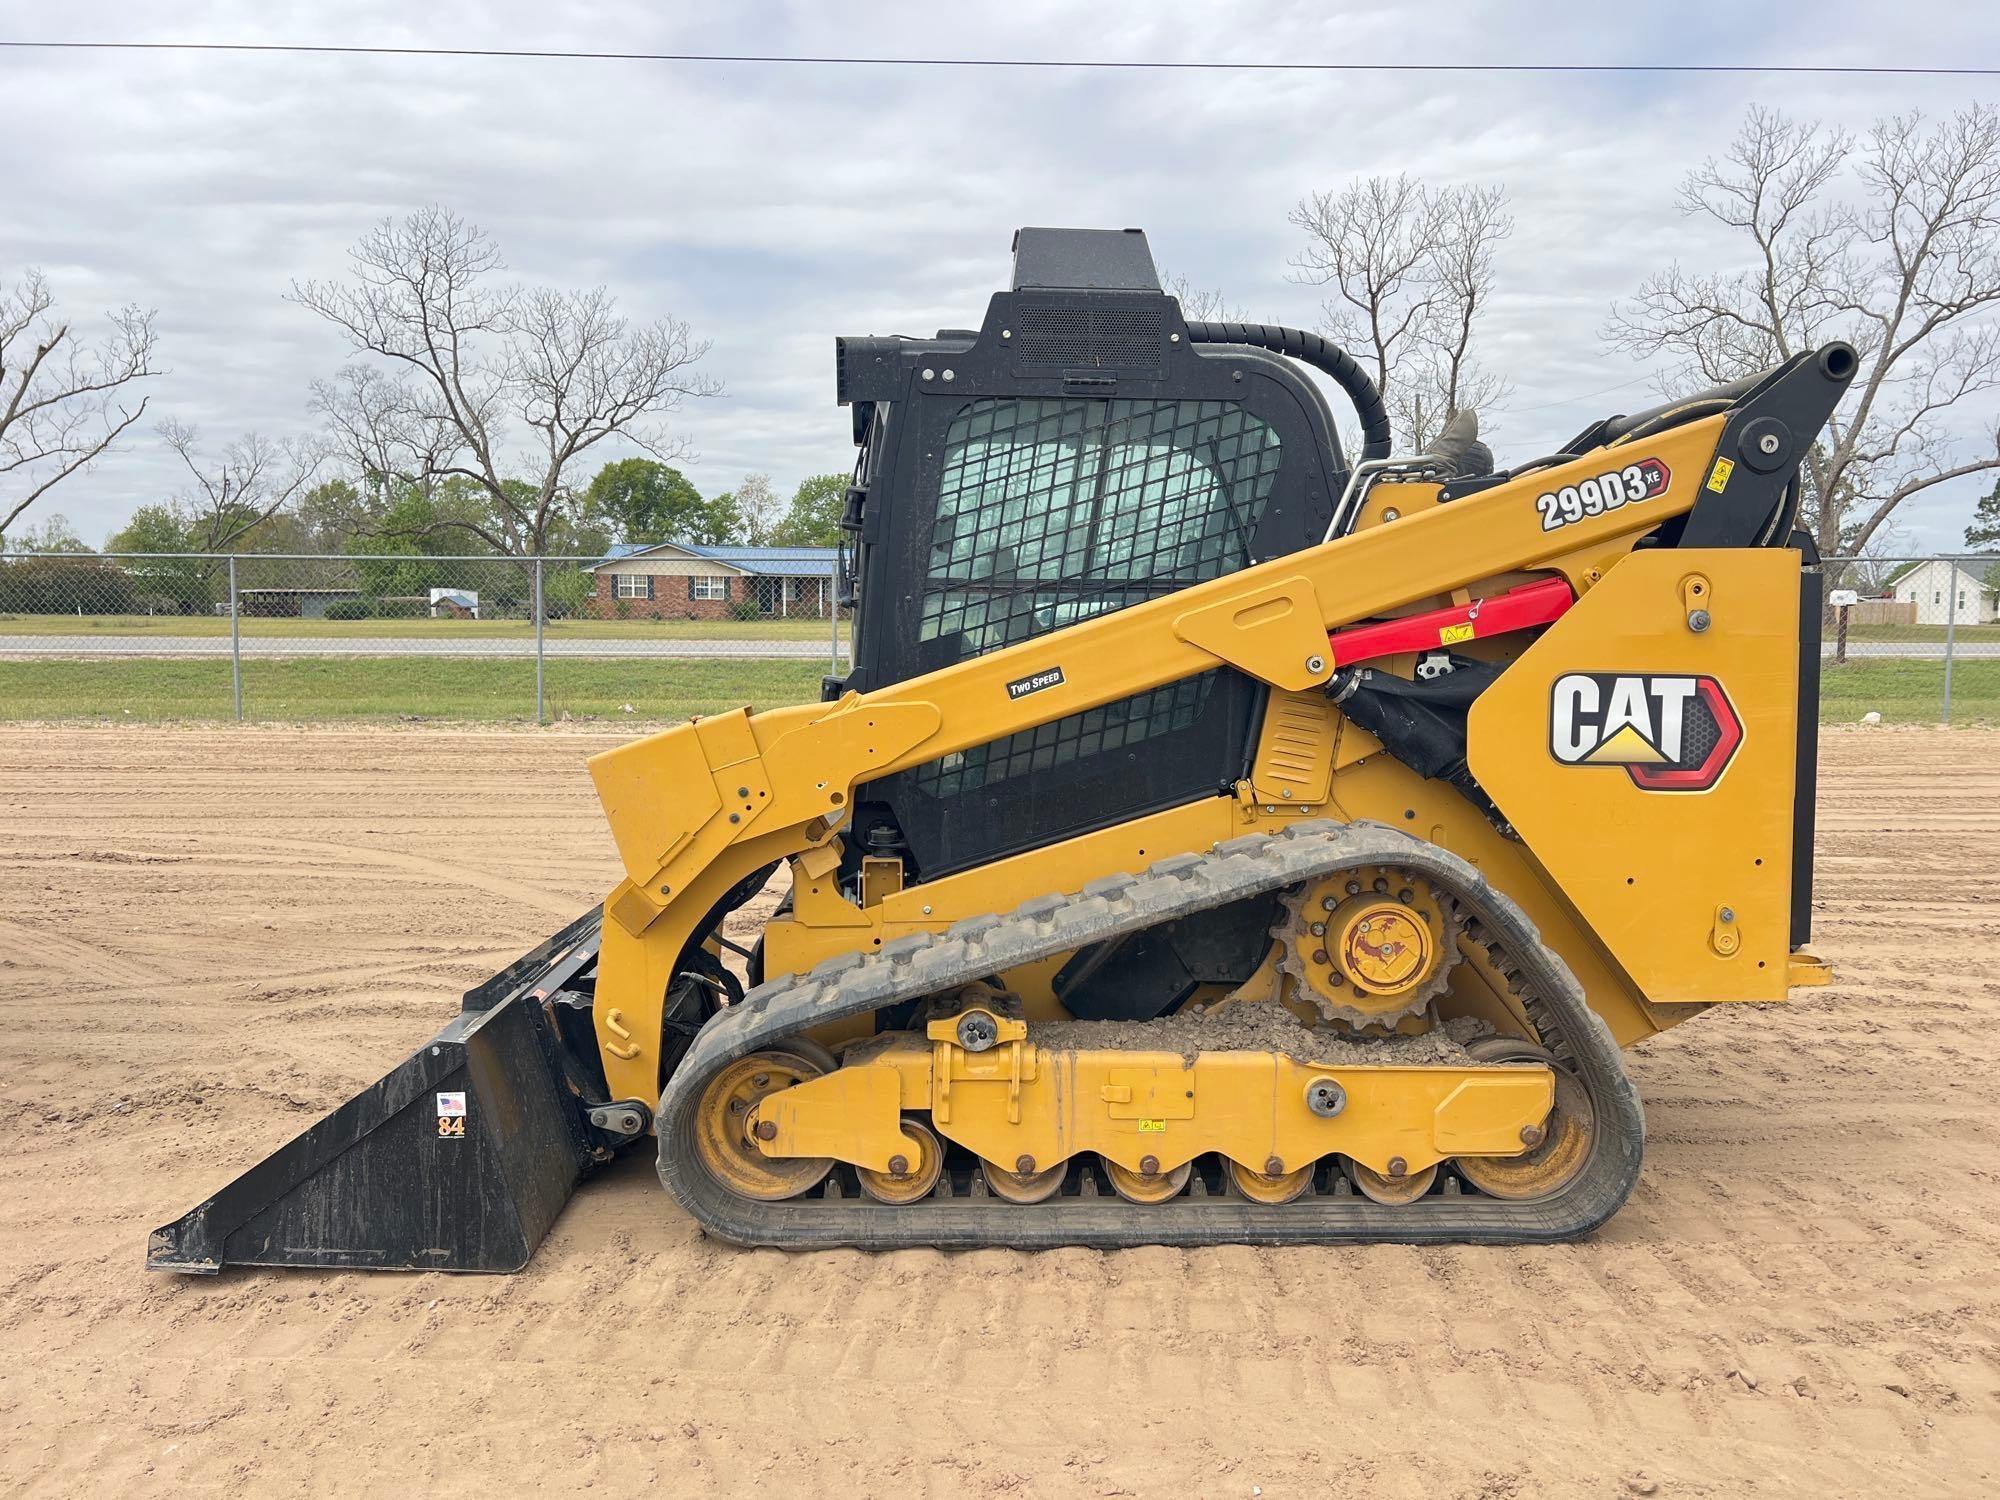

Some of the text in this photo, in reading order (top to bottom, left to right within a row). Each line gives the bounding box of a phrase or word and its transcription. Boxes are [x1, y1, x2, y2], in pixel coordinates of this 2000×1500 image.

[1537, 466, 1661, 530] 299D3 XE
[1553, 675, 1696, 763] CAT
[438, 1116, 465, 1136] 84
